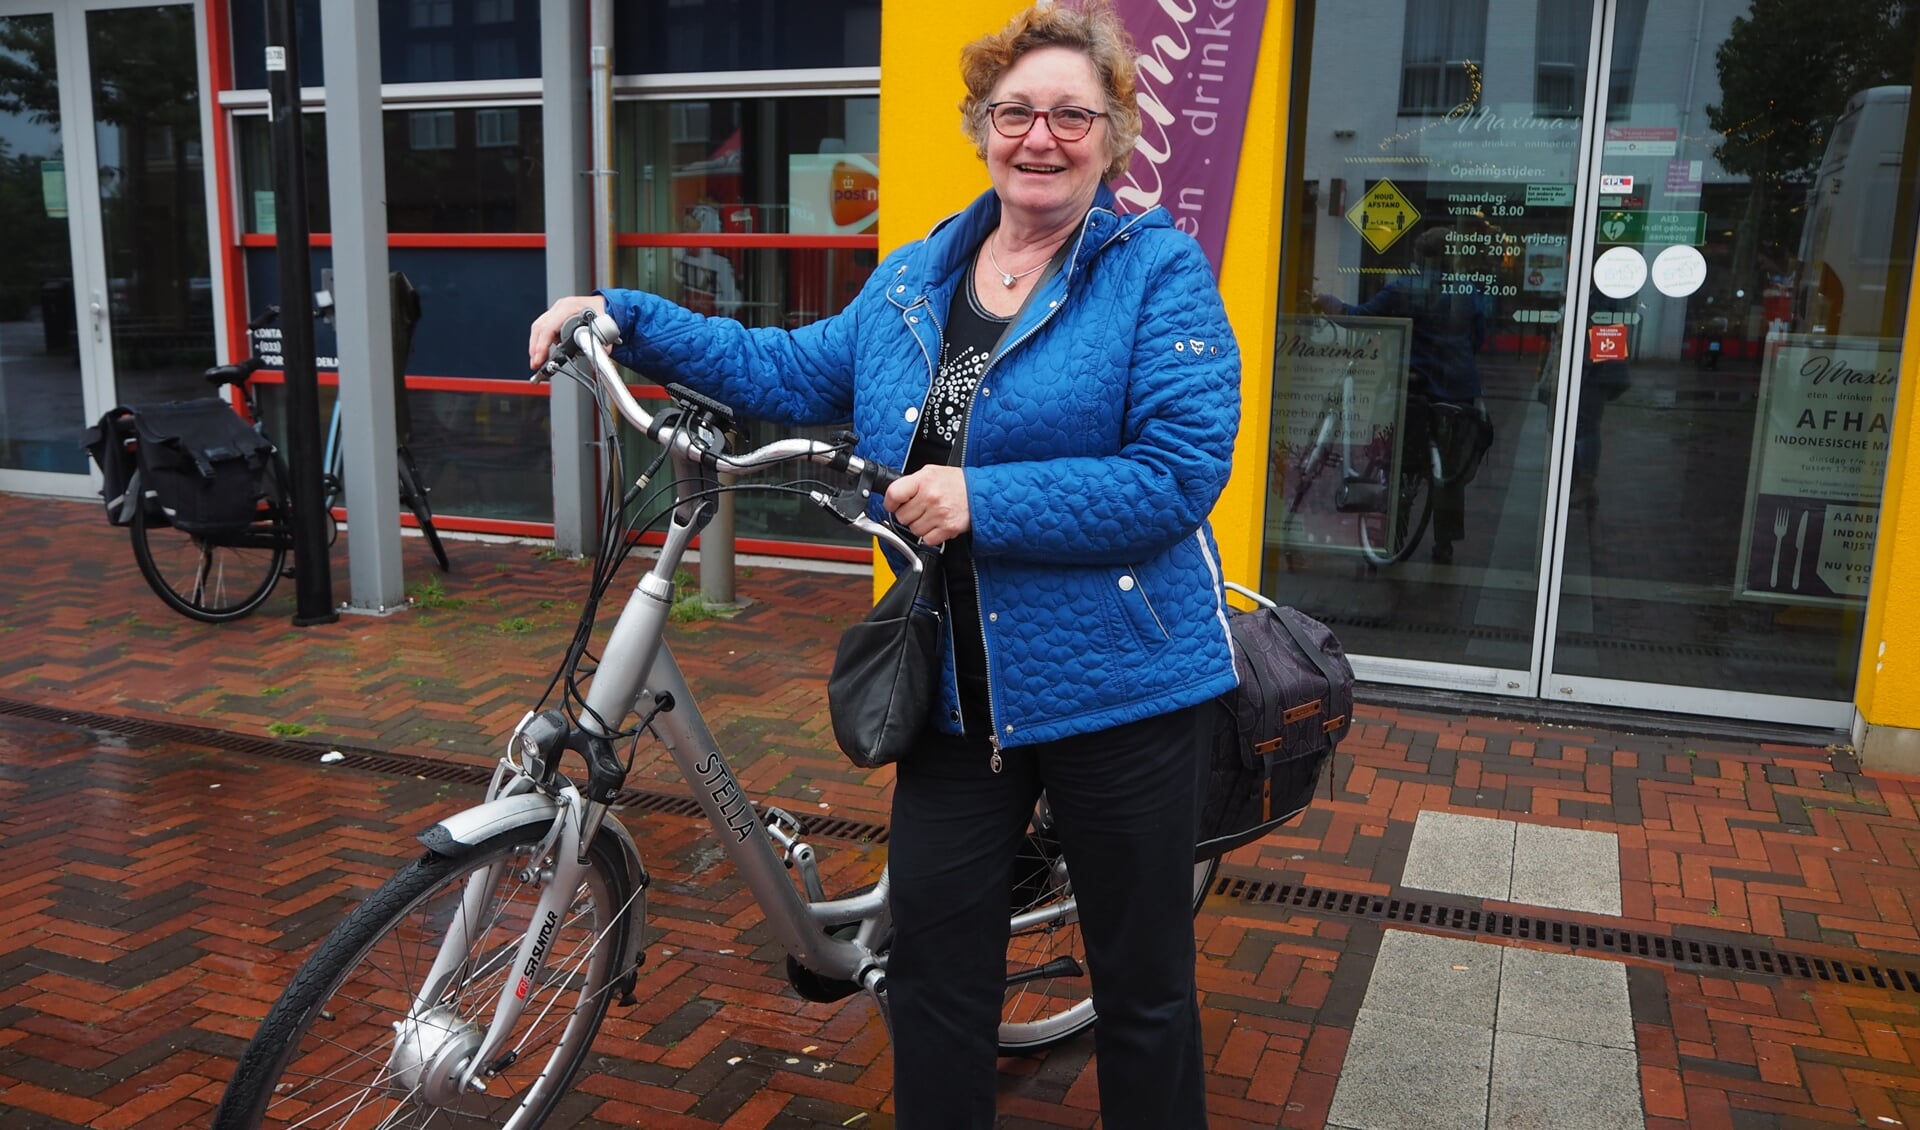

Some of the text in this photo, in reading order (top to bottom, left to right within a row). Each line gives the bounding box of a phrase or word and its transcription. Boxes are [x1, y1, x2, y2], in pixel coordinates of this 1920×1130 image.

[1444, 102, 1580, 134] Maxima's
[1450, 164, 1546, 179] Openingstijden:
[833, 188, 878, 204] postn
[1448, 192, 1507, 205] maandag:
[1448, 205, 1525, 217] vanaf 18.00
[1445, 231, 1492, 245] dinsdag
[1520, 232, 1567, 248] vrijdag:
[1444, 245, 1477, 256] 11.00
[1488, 246, 1521, 257] 20.00
[1441, 272, 1497, 285] zaterdag:
[1441, 284, 1473, 295] 11.00
[1484, 285, 1517, 296] 20.00
[260, 340, 282, 353] (033)
[1808, 391, 1828, 399] eten
[1836, 392, 1873, 402] drinken
[1774, 434, 1869, 449] INDONESISCHE
[1832, 529, 1877, 539] INDON
[1824, 561, 1842, 570] NU
[694, 752, 756, 843] STELLA
[524, 956, 539, 980] SR
[532, 910, 558, 961] SUNTOUR
